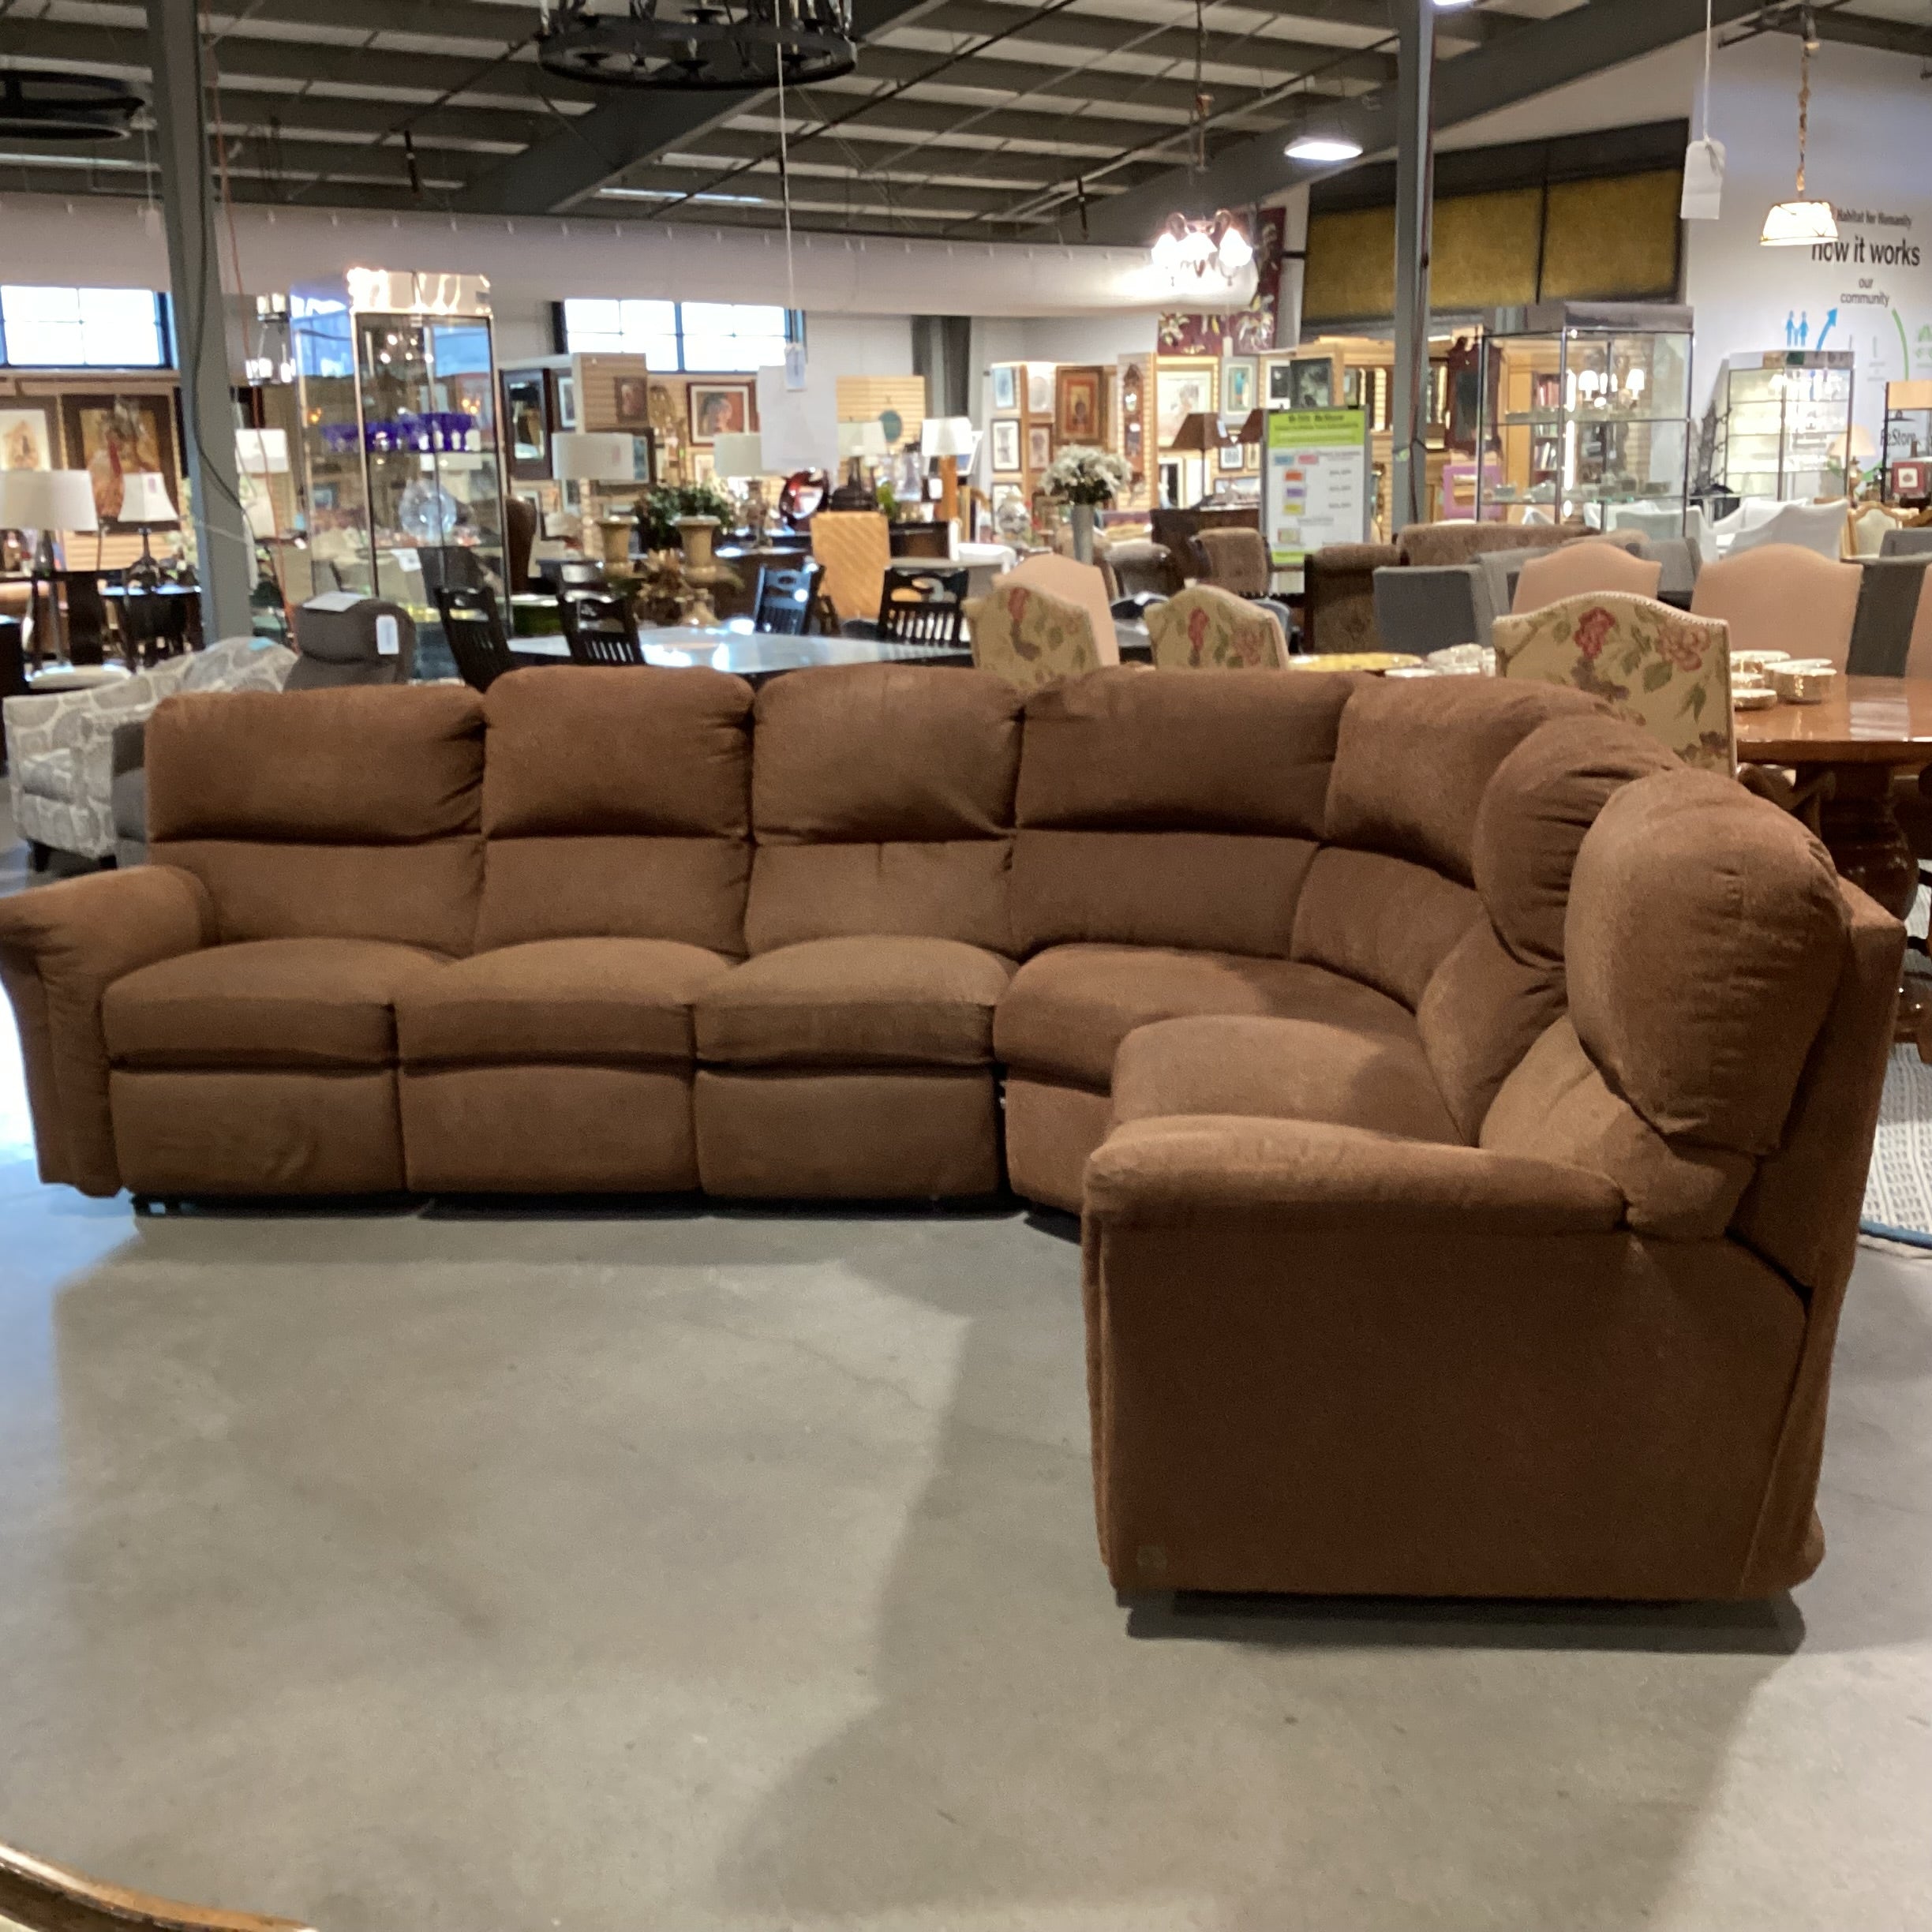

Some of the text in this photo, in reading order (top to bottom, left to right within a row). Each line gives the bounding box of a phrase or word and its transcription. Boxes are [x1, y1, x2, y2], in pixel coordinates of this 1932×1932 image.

[1854, 236, 1865, 264] it
[1870, 238, 1920, 267] works
[1859, 278, 1874, 289] our
[1840, 290, 1890, 308] community
